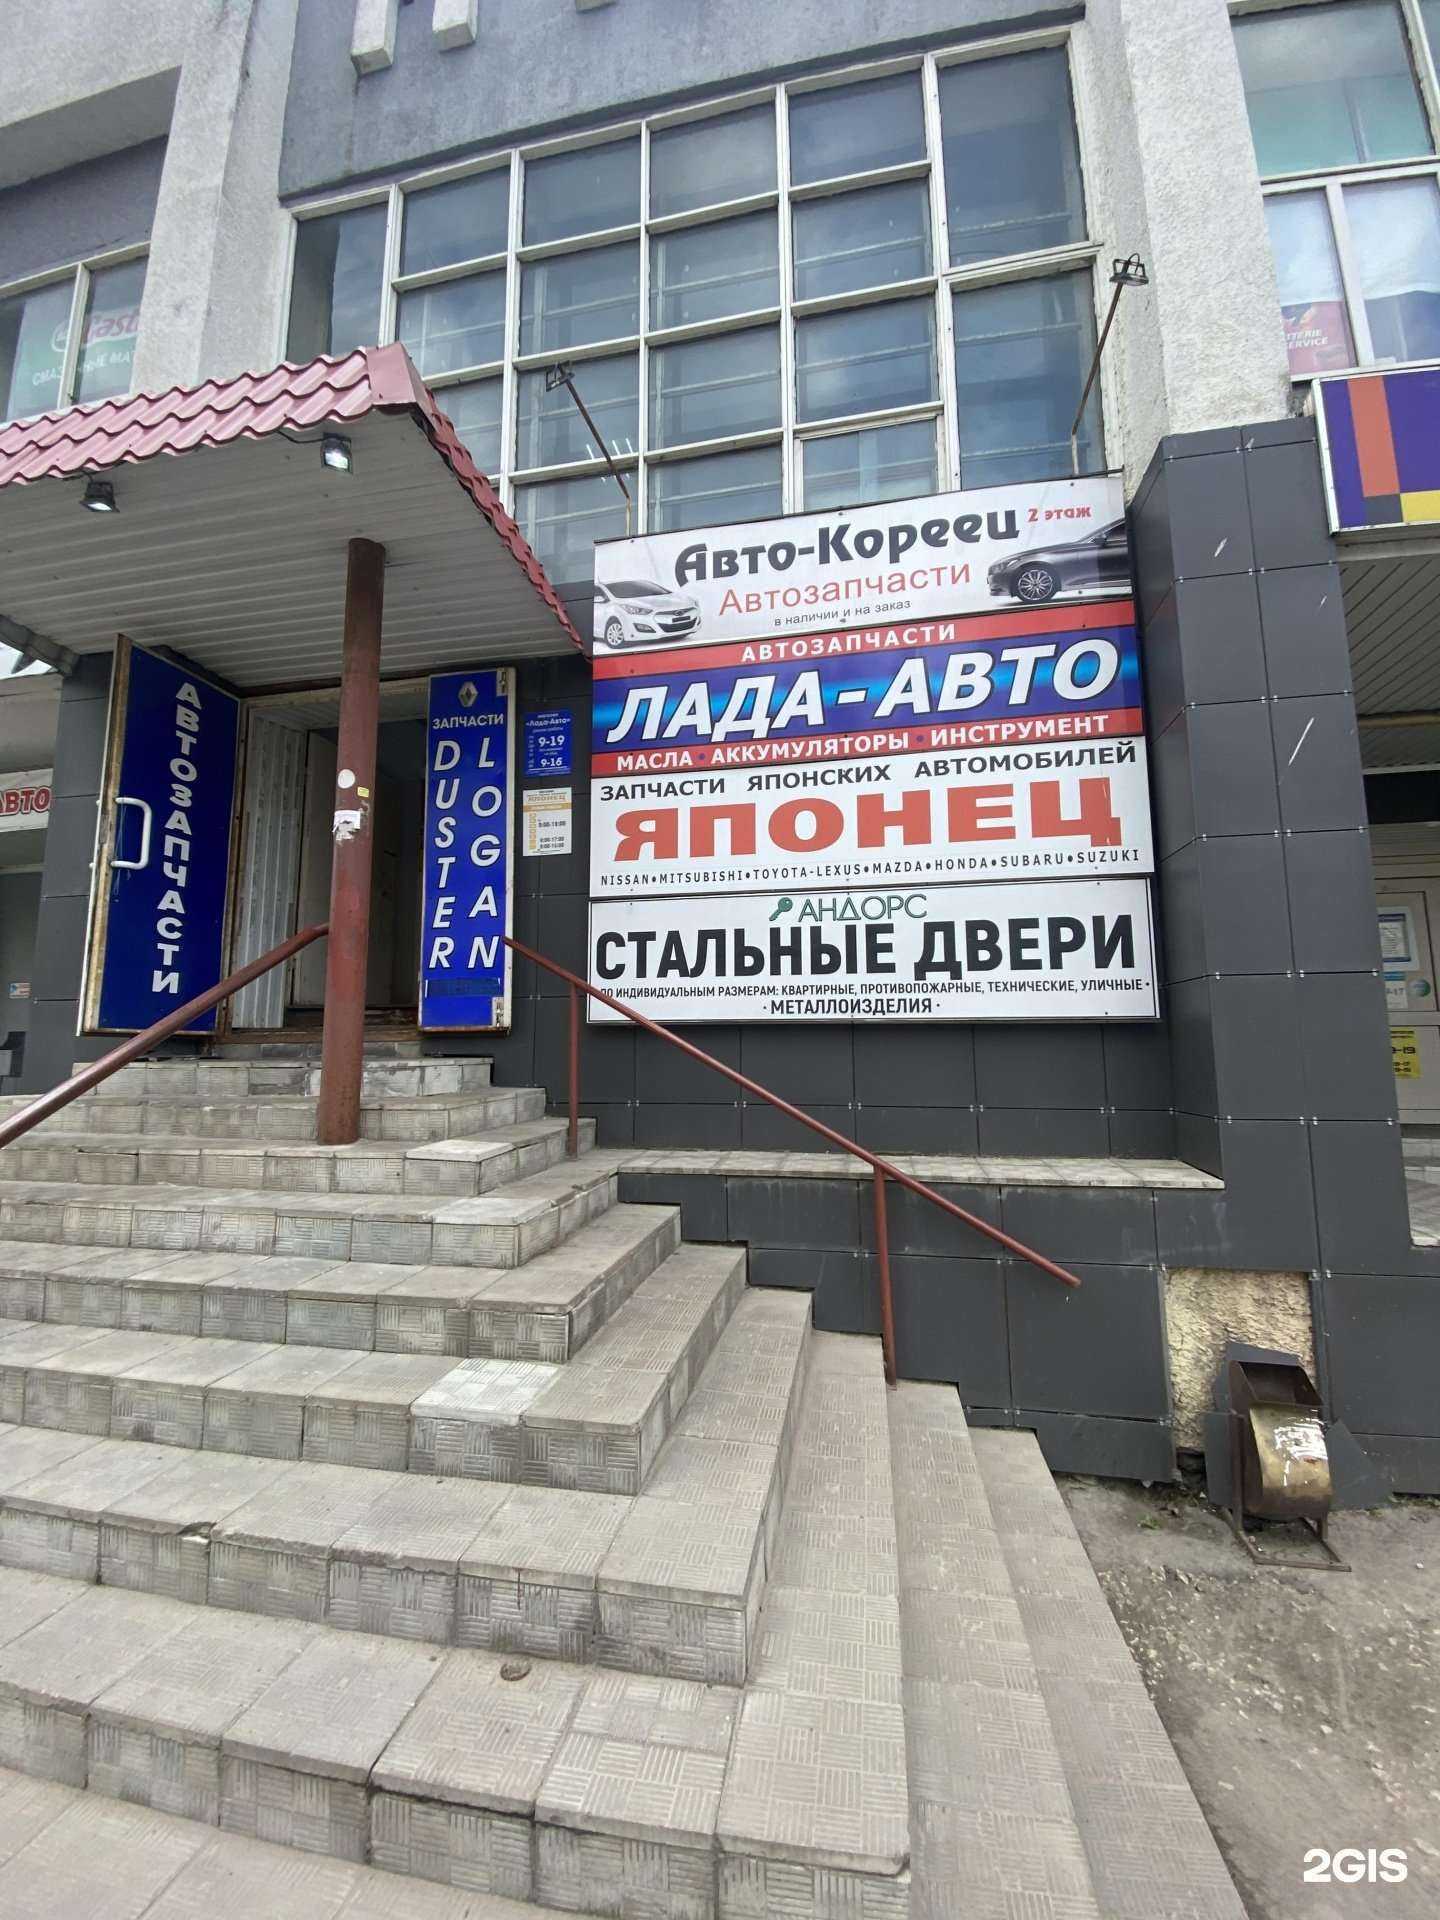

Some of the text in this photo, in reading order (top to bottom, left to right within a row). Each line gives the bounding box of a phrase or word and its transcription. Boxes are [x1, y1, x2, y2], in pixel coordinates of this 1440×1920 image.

[1028, 504, 1092, 522] 2 этаж
[675, 508, 1020, 588] Авто-Кореец
[718, 563, 971, 616] Автозапчасти
[774, 600, 912, 627] в наличии и на заказ
[741, 623, 956, 663] АВТОЗАПЧАСТИ
[432, 713, 504, 730] ЗАПЧАСТИ
[538, 735, 565, 748] 9-19
[540, 757, 563, 768] 9-16
[617, 714, 1109, 771] МАСЛА АККУМУЛЯТОРЫ ИНСТРУМЕНТ
[600, 740, 1137, 802] ЗАПЧАСТИ ЯПОНСКИХ АВТОМОБИЛЕЙ
[151, 682, 202, 995] АВТОЗАПЧАСТИ
[614, 776, 1122, 863] ЯПОНЕЦ
[429, 739, 461, 969] DUSTER
[467, 737, 502, 969] LOGAN
[601, 849, 1140, 886] NISSAN MITSUBISHI TOYOTA-LEXUS MAZDA HONDA SUBARU SUZUKI
[797, 893, 928, 923] АНДОРС
[596, 914, 1136, 982] СТАЛЬНЫЕ ДВЕРИ
[616, 986, 715, 999] ИНДИВИДУАЛЬНЫМ
[718, 985, 779, 997] РАЗМЕРАМ:
[782, 983, 857, 997] КВАРТИРНЫЕ,
[860, 981, 985, 995] ПРОТИВОПОЖАРНЫЕ,
[988, 979, 1078, 994] ТЕХНИЧЕСКИЕ,
[1081, 978, 1143, 992] УЛИЧНЫЕ
[770, 998, 932, 1015] МЕТАЛЛОИЗДЕЛИЯ
